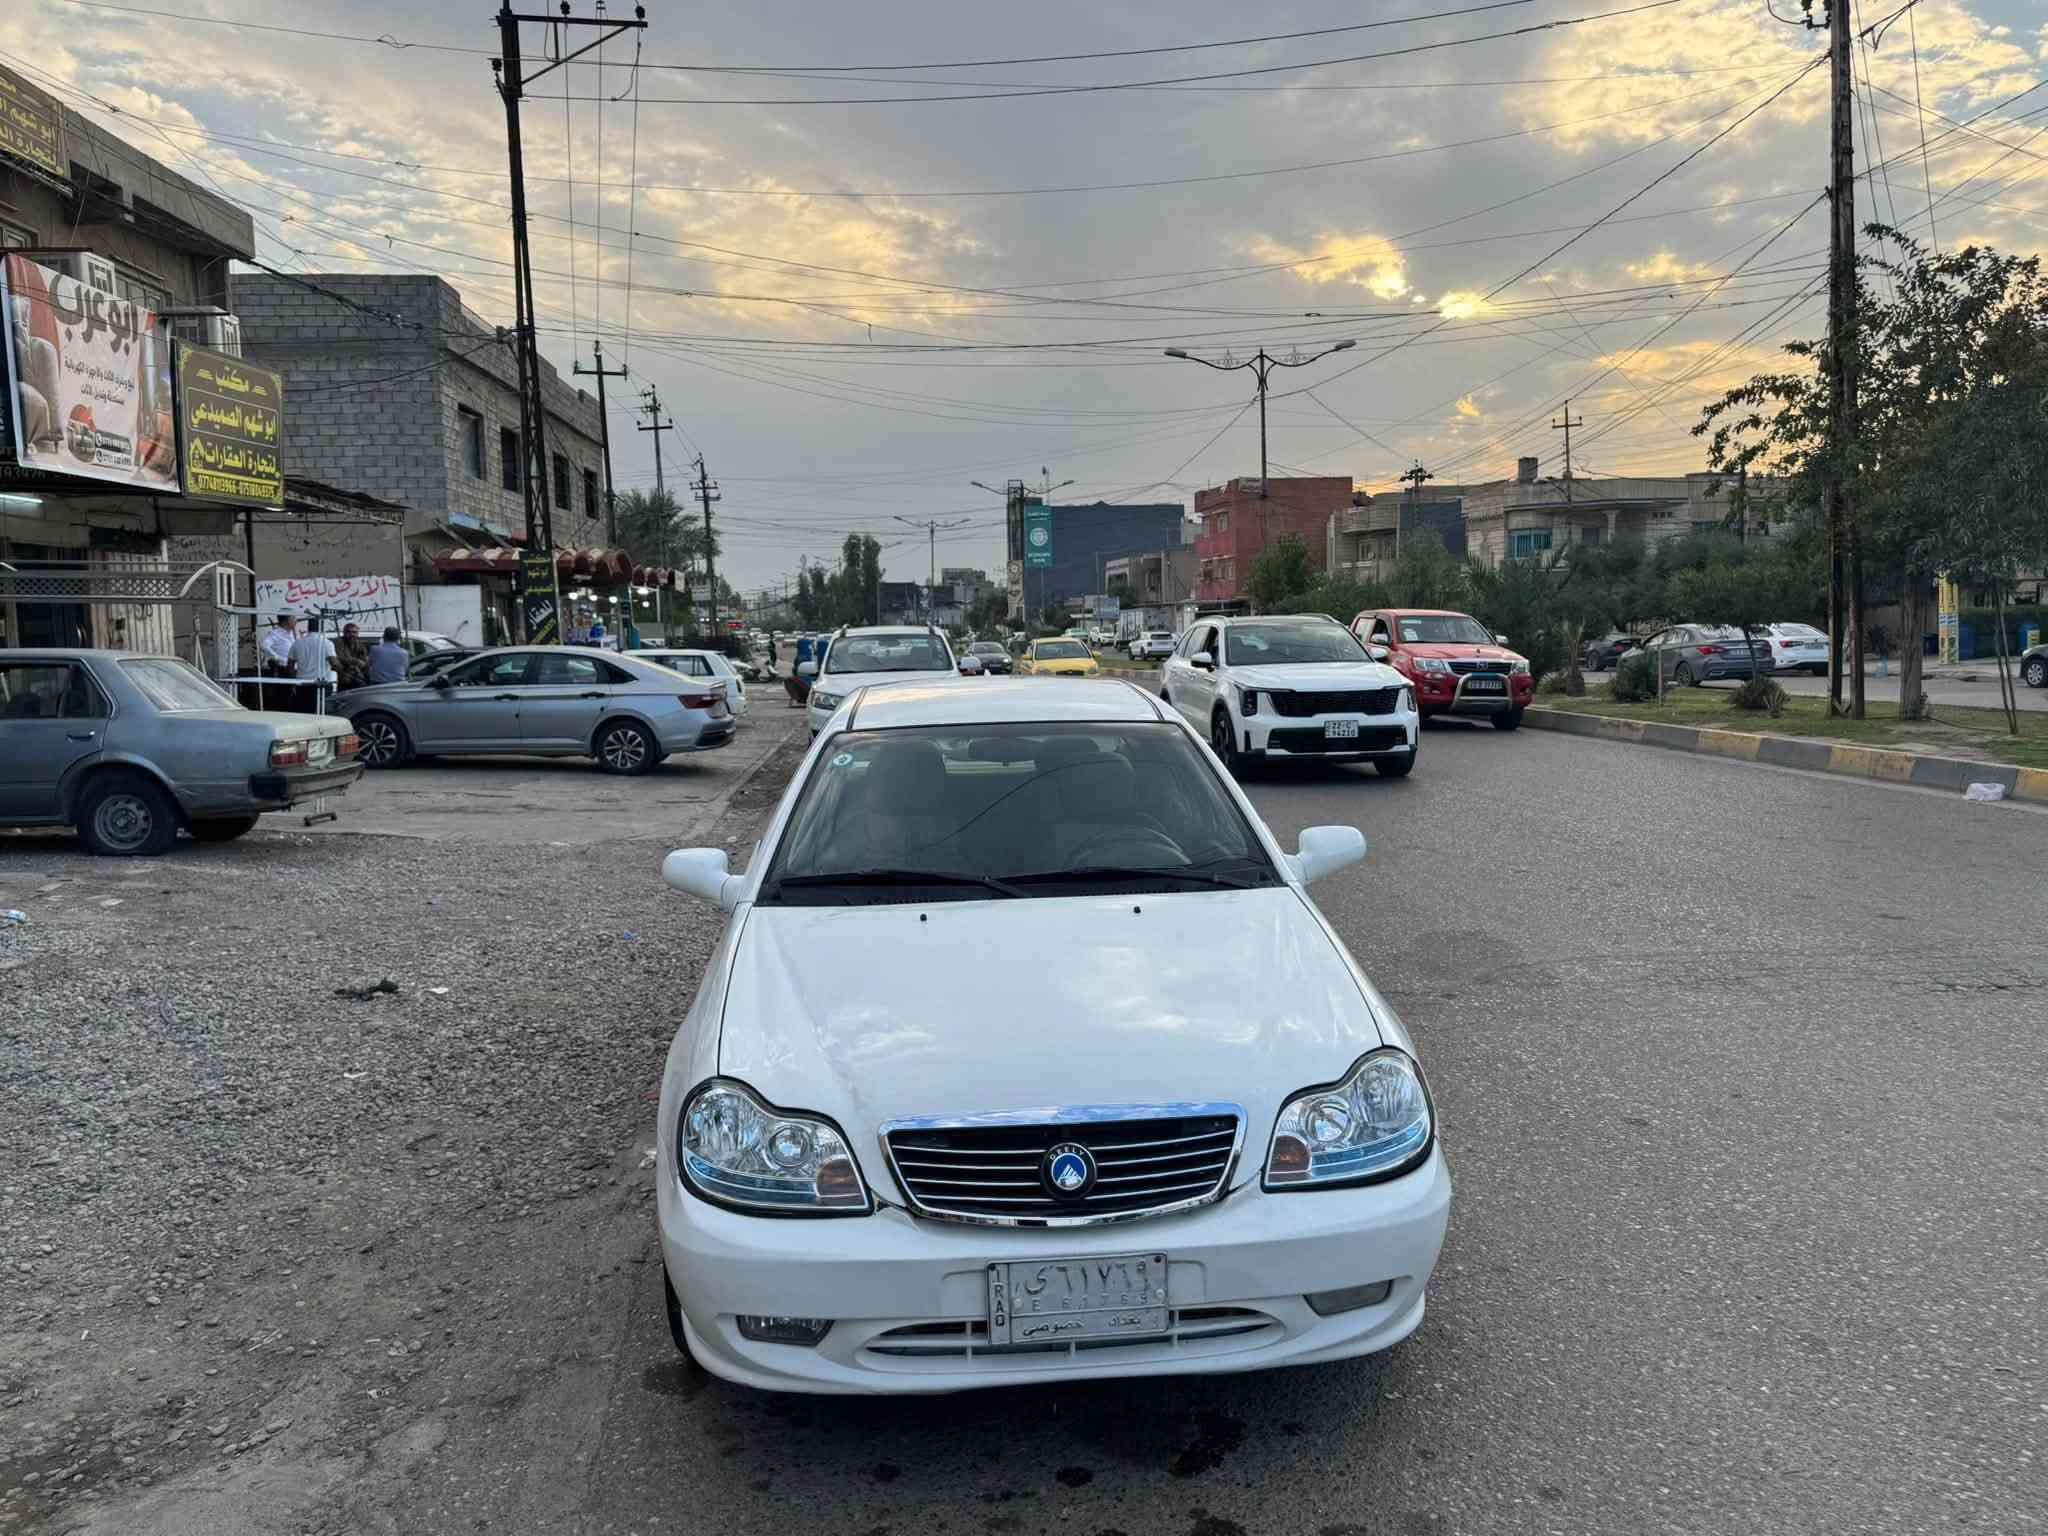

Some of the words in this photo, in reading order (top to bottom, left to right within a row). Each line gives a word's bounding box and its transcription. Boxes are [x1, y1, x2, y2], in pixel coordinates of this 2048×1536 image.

[215, 366, 249, 392] مكتب
[204, 441, 246, 470] العقارات
[991, 1268, 1006, 1328] IRAQ
